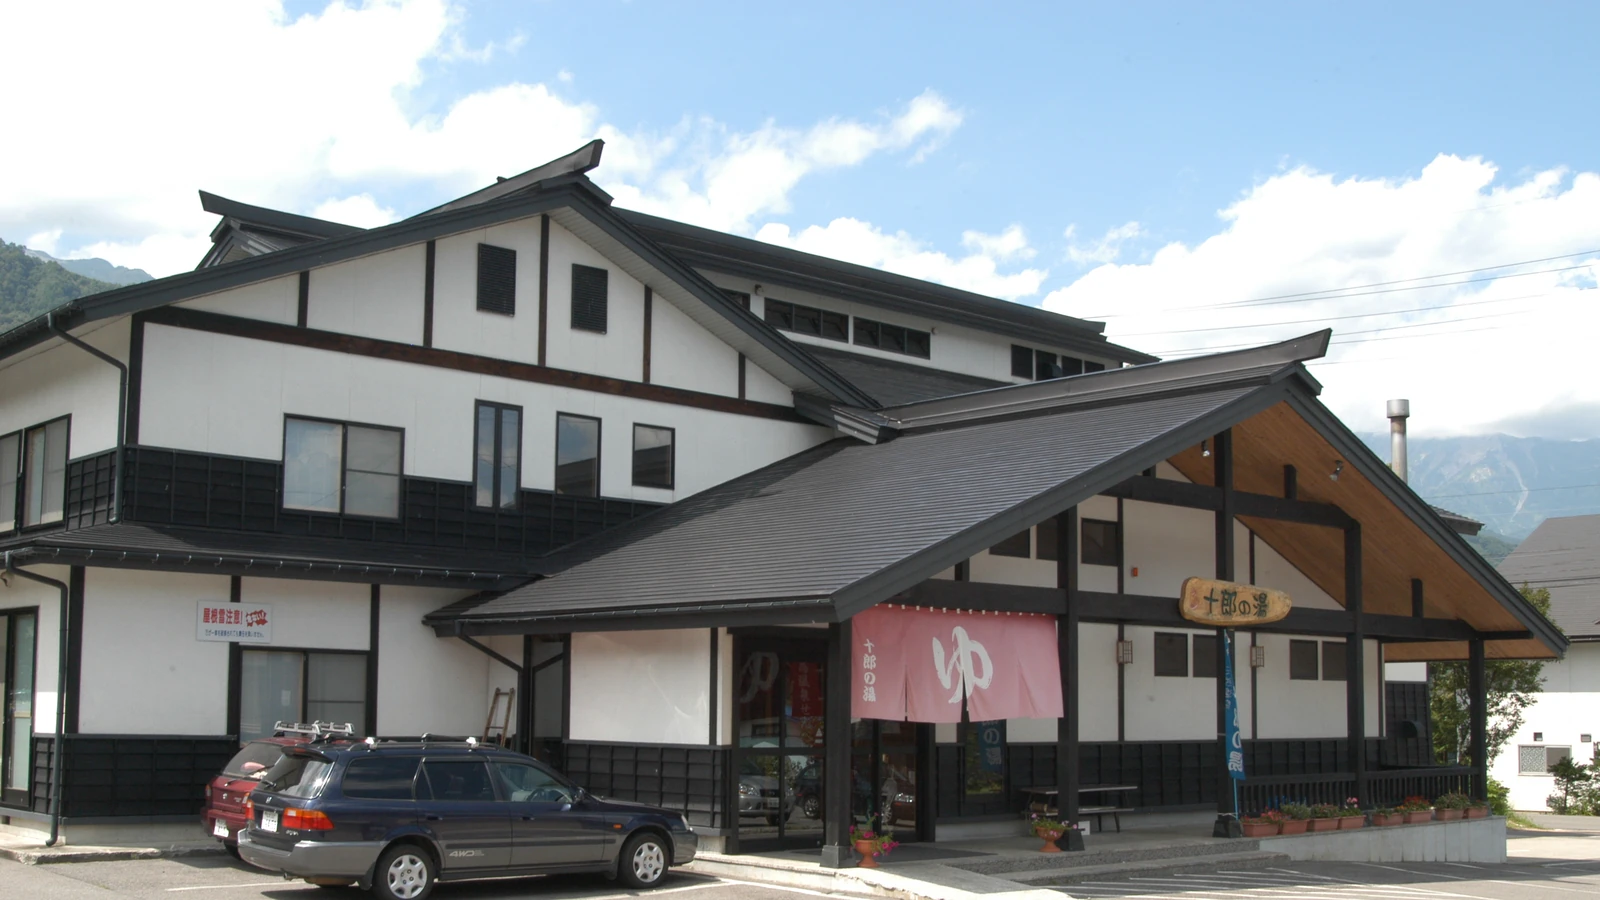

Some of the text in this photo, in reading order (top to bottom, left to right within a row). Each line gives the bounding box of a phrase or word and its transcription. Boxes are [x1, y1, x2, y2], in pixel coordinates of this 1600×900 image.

[1203, 587, 1268, 617] 十郎の湯
[862, 638, 877, 702] 十郎の湯
[932, 626, 993, 704] ゆ
